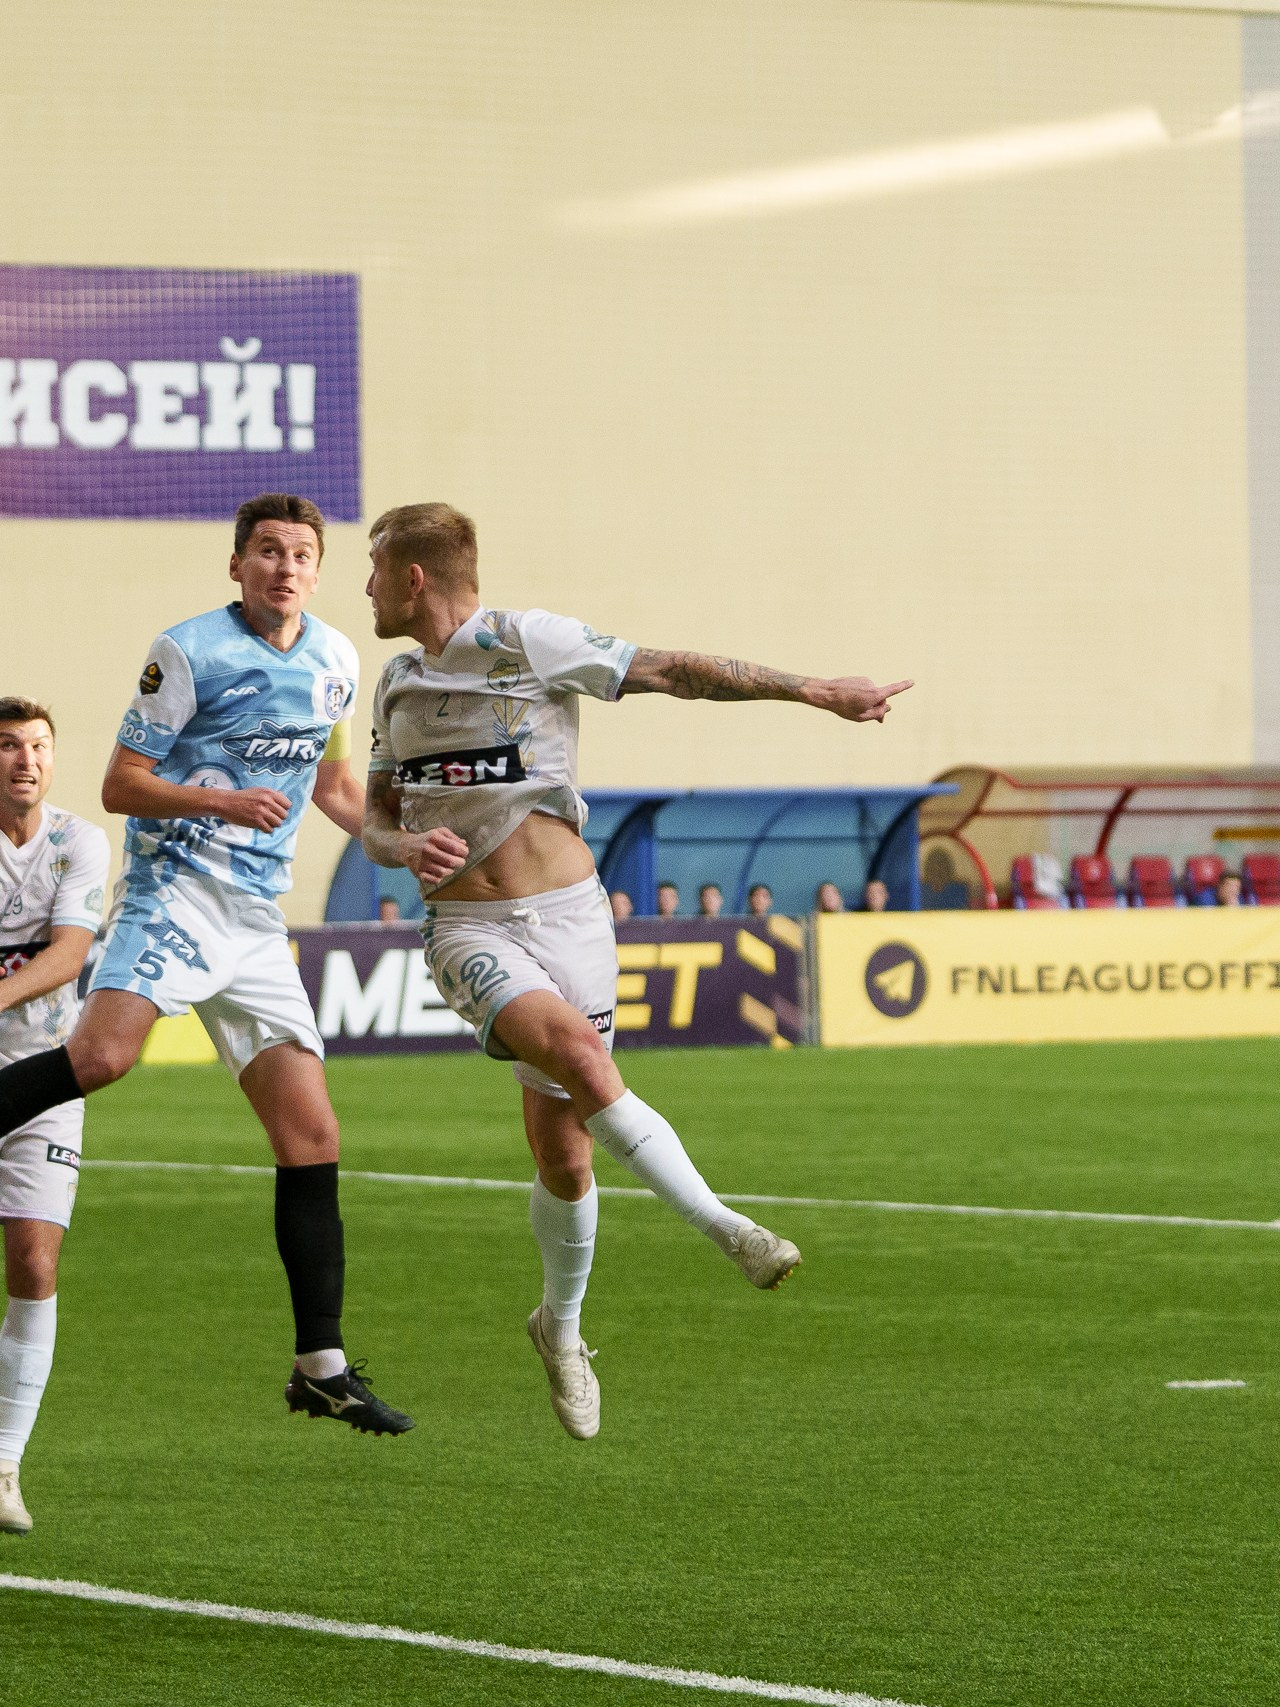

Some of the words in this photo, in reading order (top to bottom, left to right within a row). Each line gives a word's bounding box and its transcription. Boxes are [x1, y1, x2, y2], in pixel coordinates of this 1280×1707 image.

[436, 692, 451, 719] 2
[132, 949, 168, 981] 5
[460, 952, 511, 1005] 2
